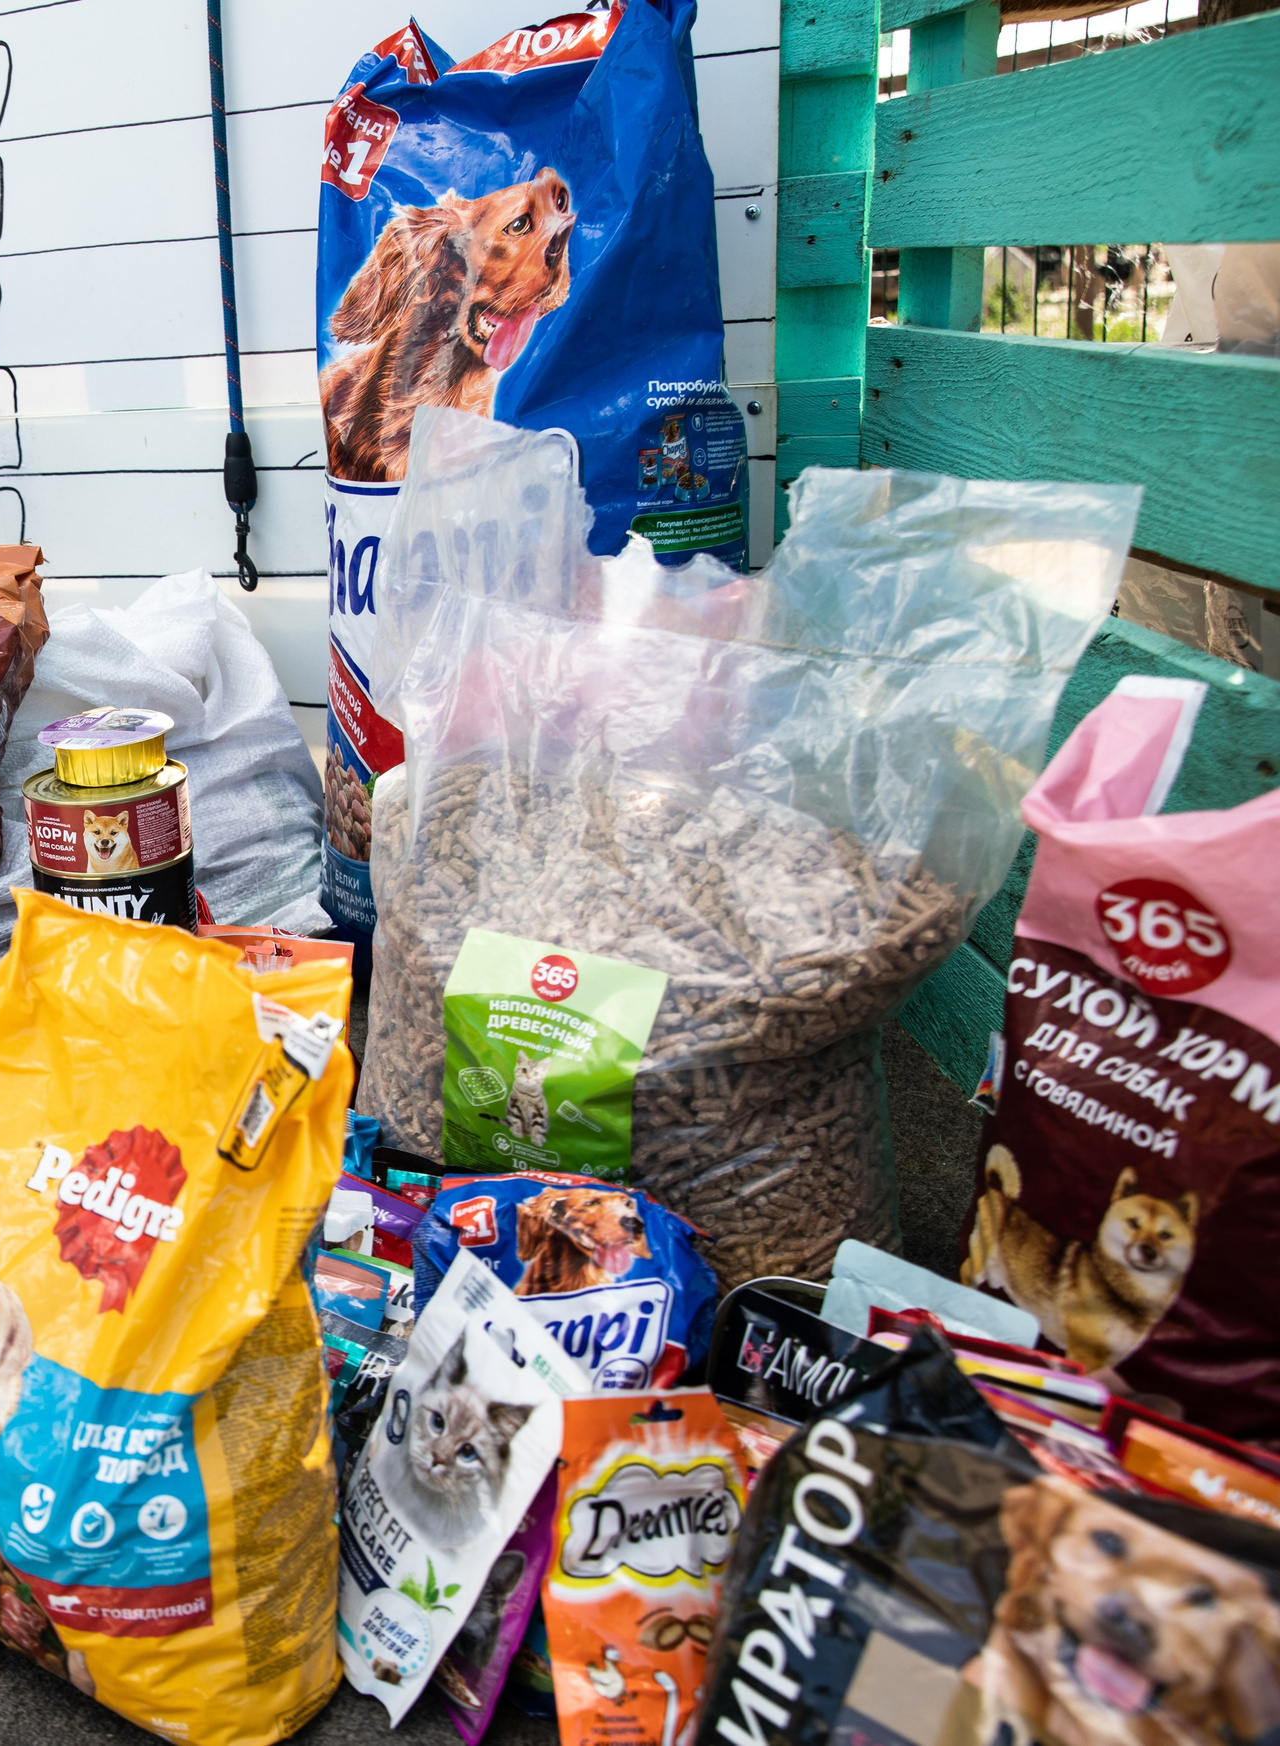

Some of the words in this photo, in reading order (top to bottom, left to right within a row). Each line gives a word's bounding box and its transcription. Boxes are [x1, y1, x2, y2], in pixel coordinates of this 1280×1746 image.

[35, 825, 77, 845] КОРМ
[39, 841, 51, 850] ДЛЯ
[51, 843, 75, 852] СОБАК
[44, 852, 77, 863] ГОВЯДИНОЙ
[334, 869, 360, 891] БЕЛКИ
[1100, 892, 1226, 957] 365
[533, 962, 578, 989] 365
[1123, 955, 1193, 982] дней
[537, 985, 562, 998] дней
[487, 1014, 593, 1053] ДРЕВЕСНЫЙ
[1007, 957, 1159, 1049] СУХОЙ
[1158, 1027, 1280, 1126] КОРМ
[1024, 1022, 1102, 1069] ДЛЯ
[1096, 1056, 1199, 1123] СОБАК
[95, 1443, 189, 1484] ПОРОД
[359, 1521, 397, 1577] CARE
[384, 1516, 414, 1554] FIT
[362, 1618, 410, 1660] ДЕЙСТВИЕ
[370, 1606, 421, 1651] ТРОЙНОЕ
